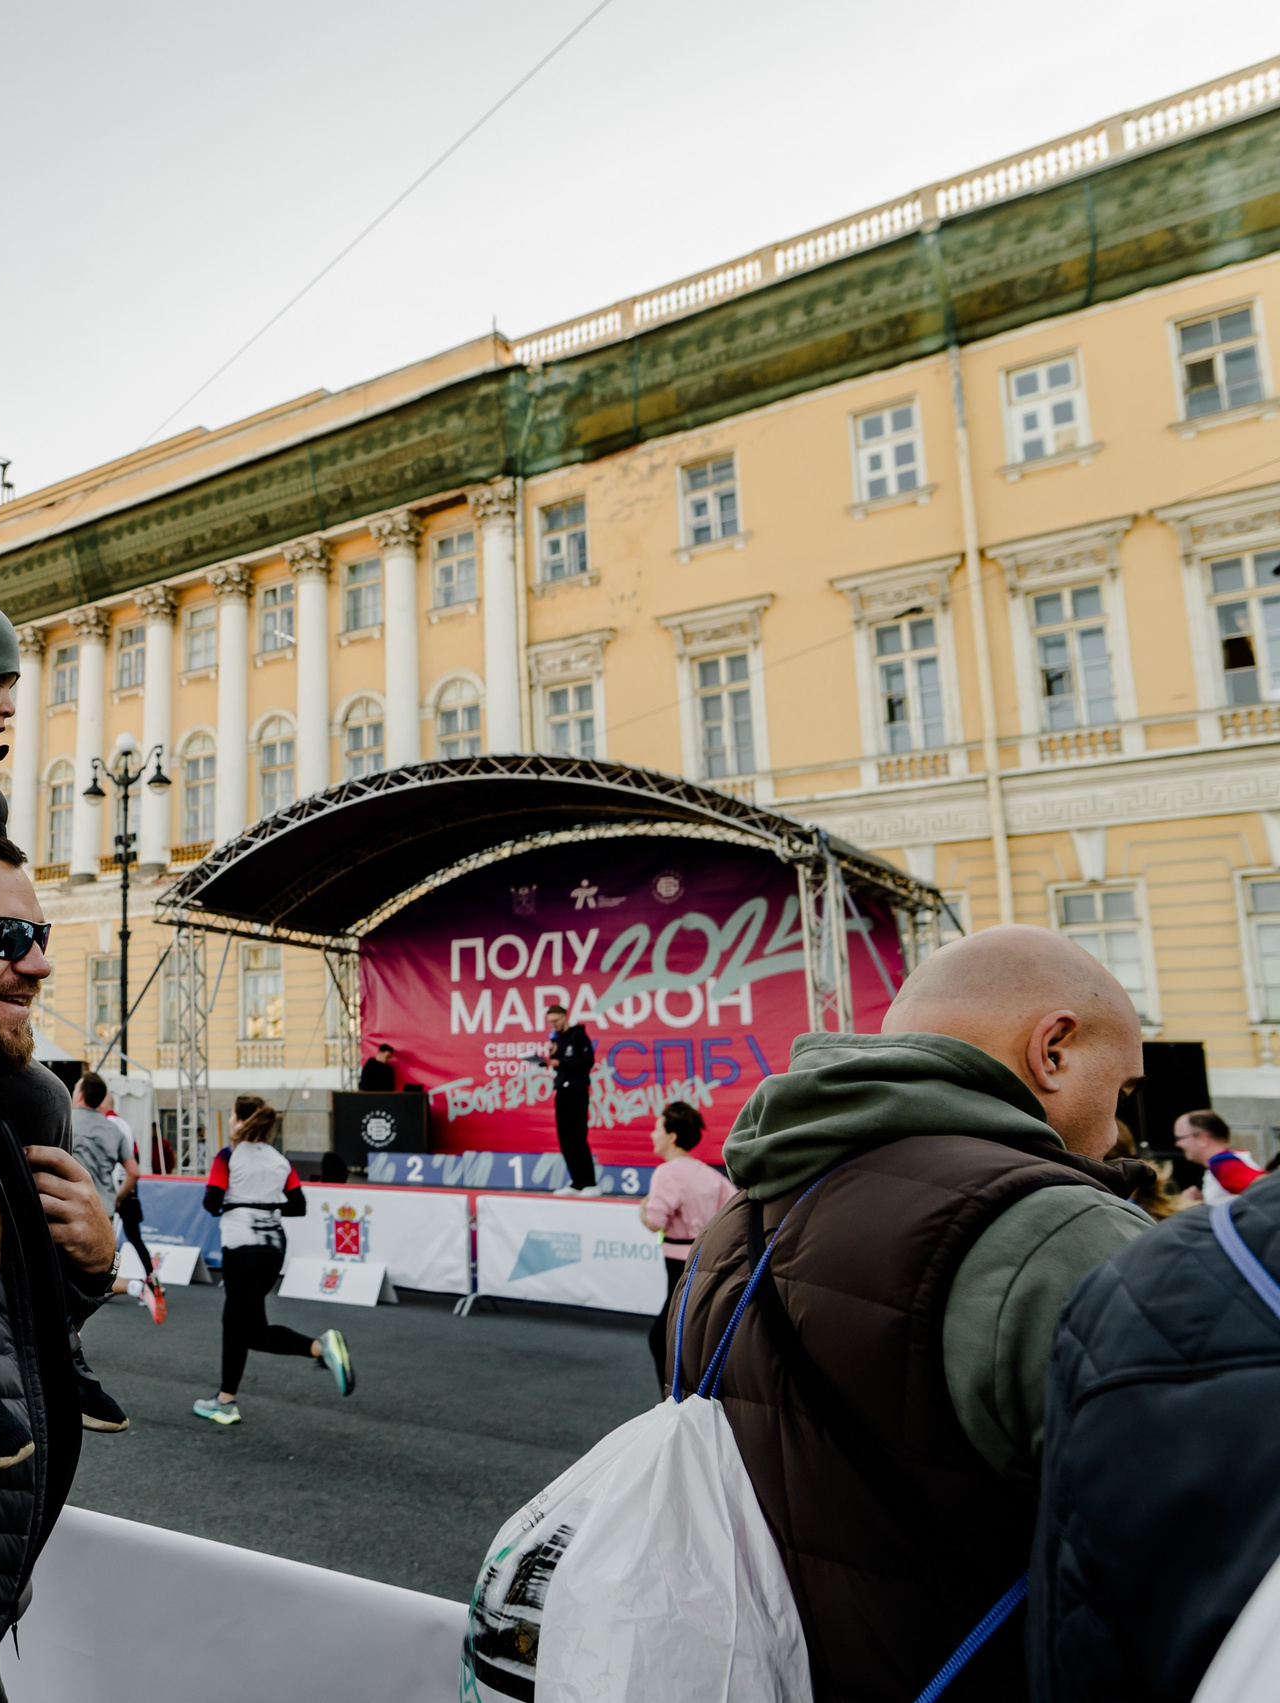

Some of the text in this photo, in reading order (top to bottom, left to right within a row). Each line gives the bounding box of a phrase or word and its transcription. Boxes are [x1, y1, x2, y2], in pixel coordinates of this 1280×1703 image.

[450, 927, 600, 983] ПОЛУ
[450, 976, 754, 1035] МАРАФОН
[483, 1041, 552, 1059] СЕВЕРН
[406, 1155, 641, 1194] 2 1 3
